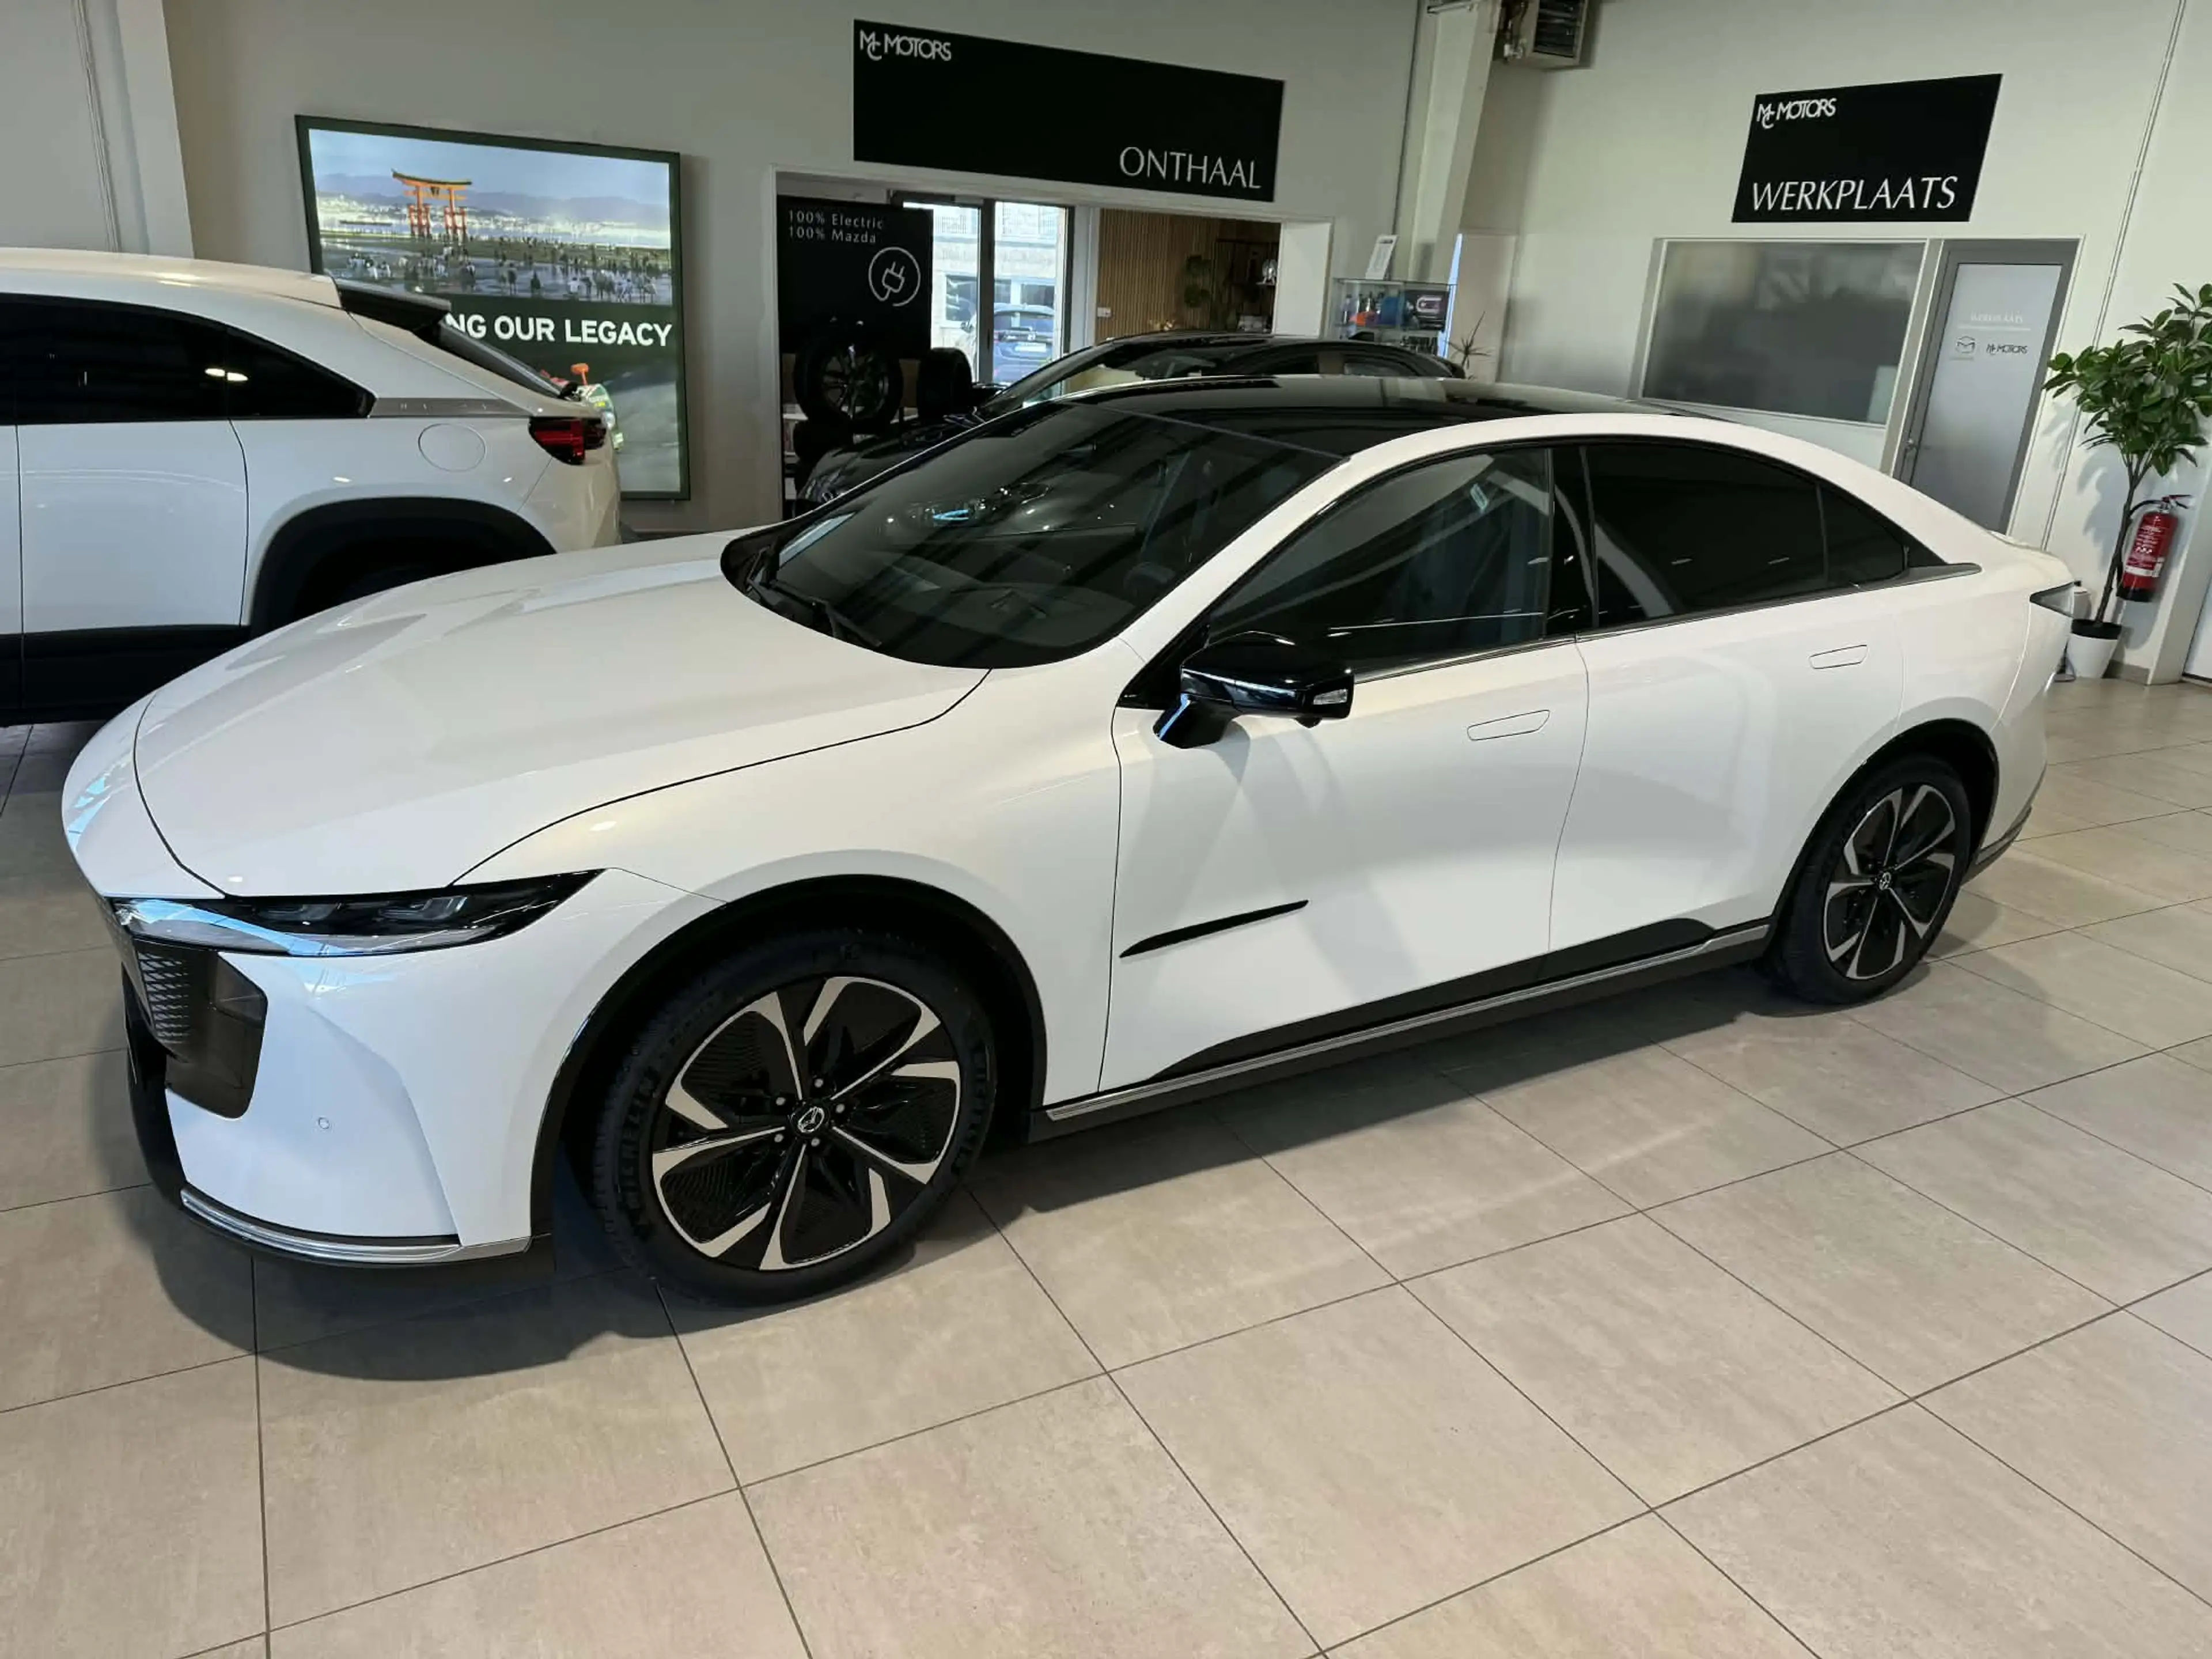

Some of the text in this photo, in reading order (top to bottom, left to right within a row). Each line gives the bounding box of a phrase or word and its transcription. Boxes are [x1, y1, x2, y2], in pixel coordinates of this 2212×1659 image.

[884, 33, 952, 61] MOTORS
[1776, 97, 1837, 121] MOTORS
[1119, 146, 1262, 189] ONTHAAL
[1752, 176, 1958, 211] WERKPLAATS
[789, 209, 884, 230] 100% Electric
[789, 225, 876, 244] 100% Mazda
[494, 315, 555, 342] OUR
[565, 320, 672, 346] LEGACY
